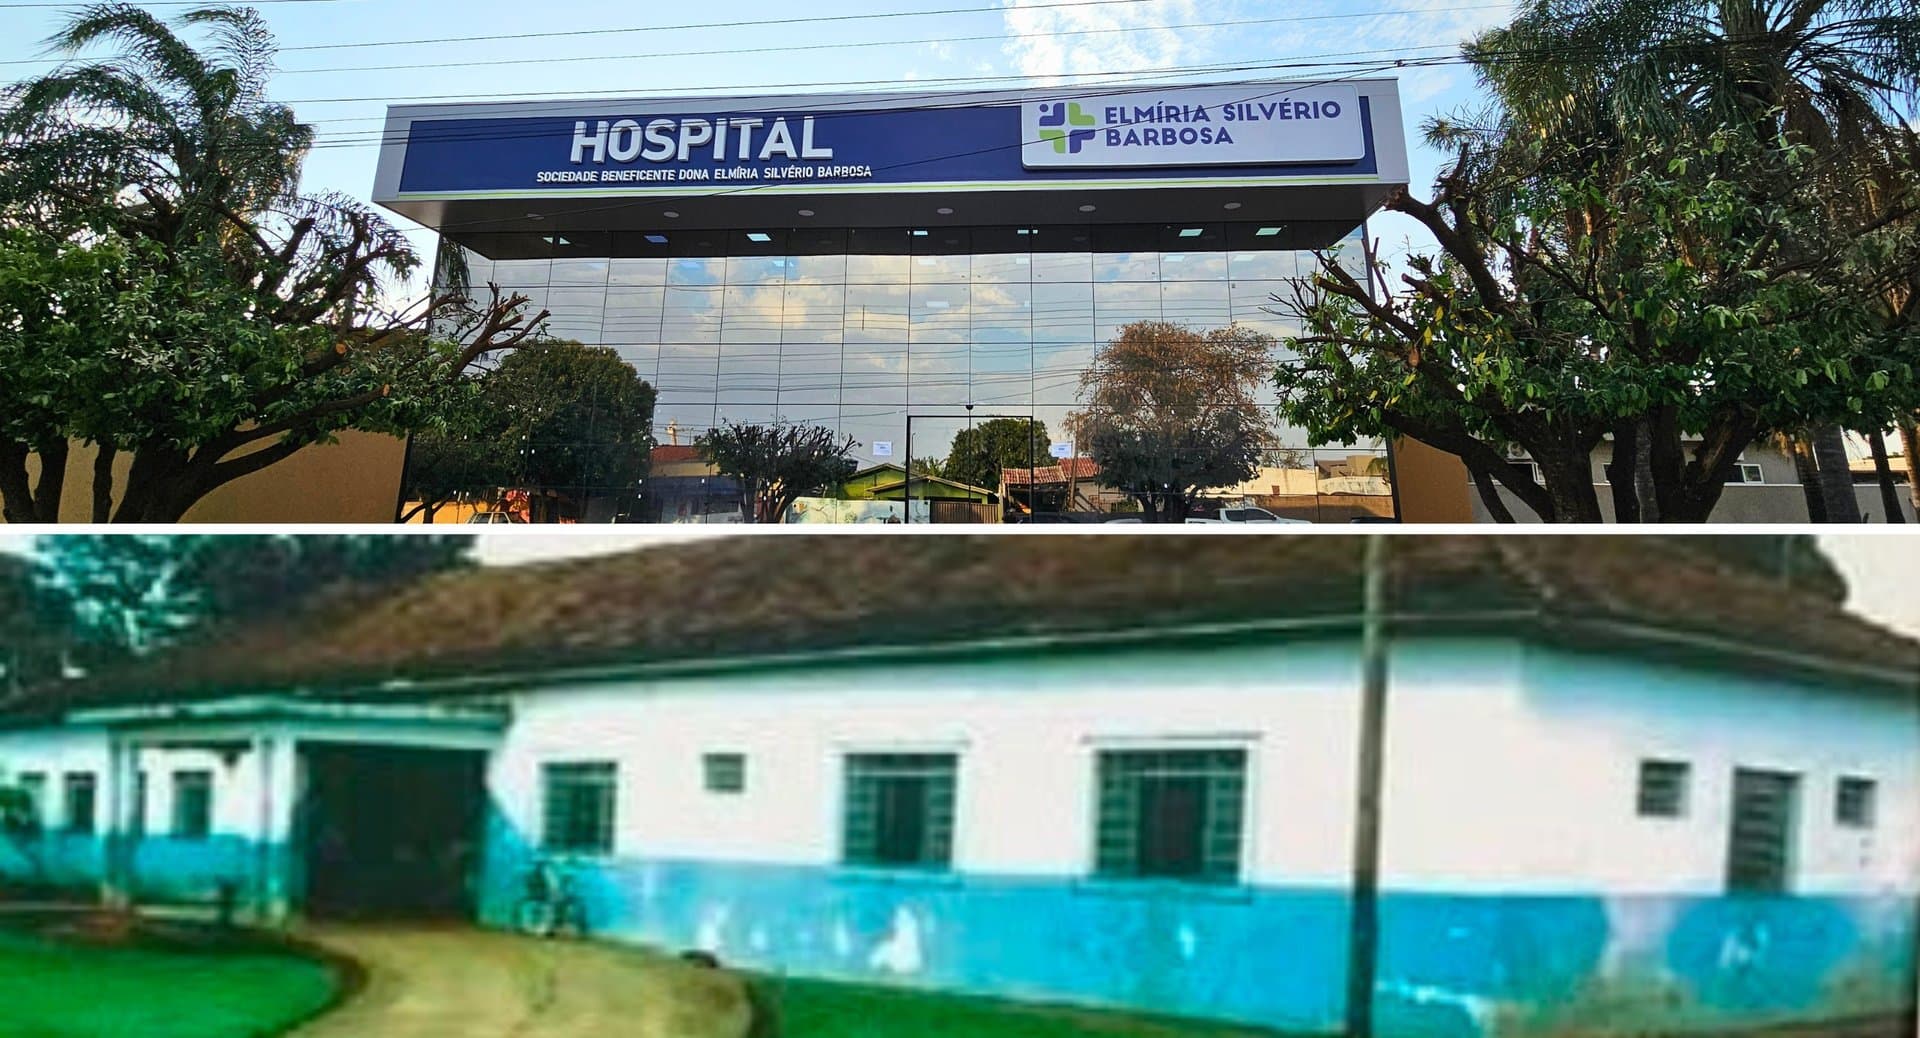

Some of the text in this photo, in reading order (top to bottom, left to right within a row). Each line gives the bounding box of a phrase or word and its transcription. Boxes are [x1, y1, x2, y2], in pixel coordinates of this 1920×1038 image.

[1105, 98, 1341, 125] ELMÍRIA SILVÉRIO
[570, 115, 833, 164] HOSPITAL
[1106, 127, 1234, 146] BARBOSA
[536, 165, 872, 183] SOCIEDADE BENEFICENTE DONA ELMÍRIA SILVÉRIO BARBOSA
